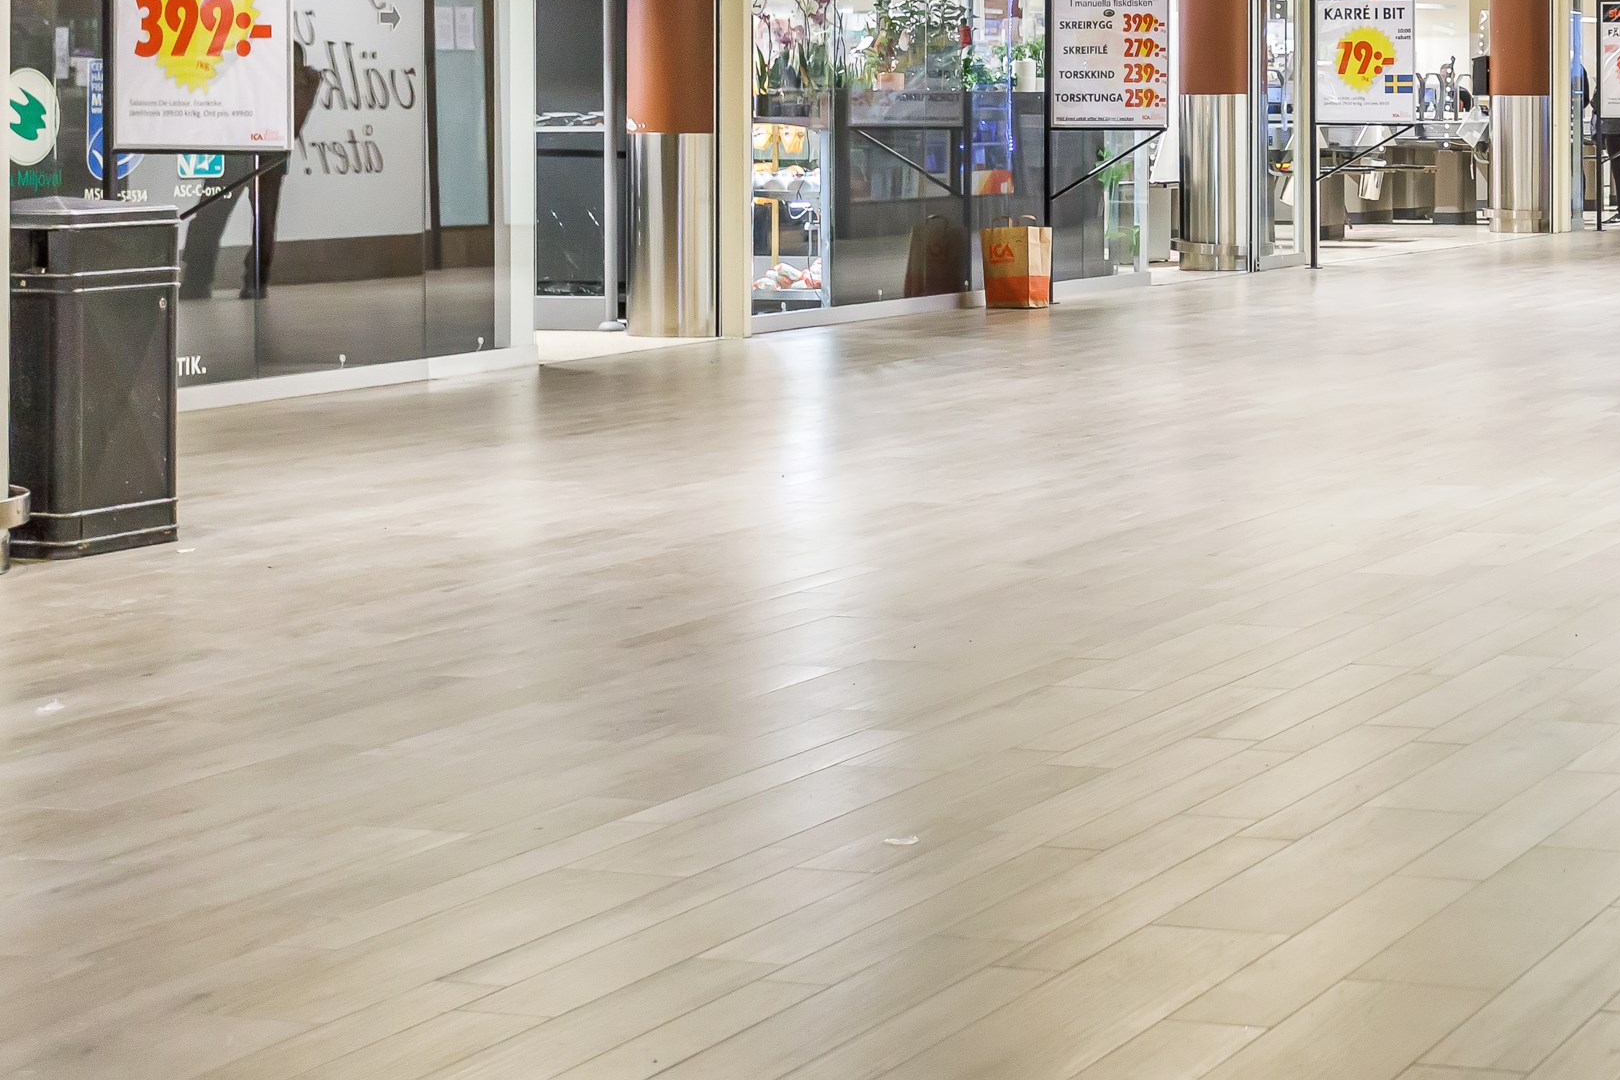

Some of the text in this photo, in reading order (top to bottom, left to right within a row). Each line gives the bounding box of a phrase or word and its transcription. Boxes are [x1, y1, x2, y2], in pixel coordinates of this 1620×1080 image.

[1113, 0, 1153, 7] fiskdisken
[1324, 5, 1371, 20] KARRÉ
[1383, 8, 1405, 20] BIT
[1059, 13, 1165, 33] SKREIRYGG 399:-
[1063, 38, 1166, 58] SKREIFILÉ 279:-
[1336, 41, 1394, 74] 79:-
[1059, 63, 1167, 83] TORSKKIND 239:-
[1055, 88, 1166, 108] TORSKTUNGA 259:-
[251, 133, 264, 141] ICA
[989, 244, 1015, 258] ICA
[177, 355, 207, 376] TIK.
